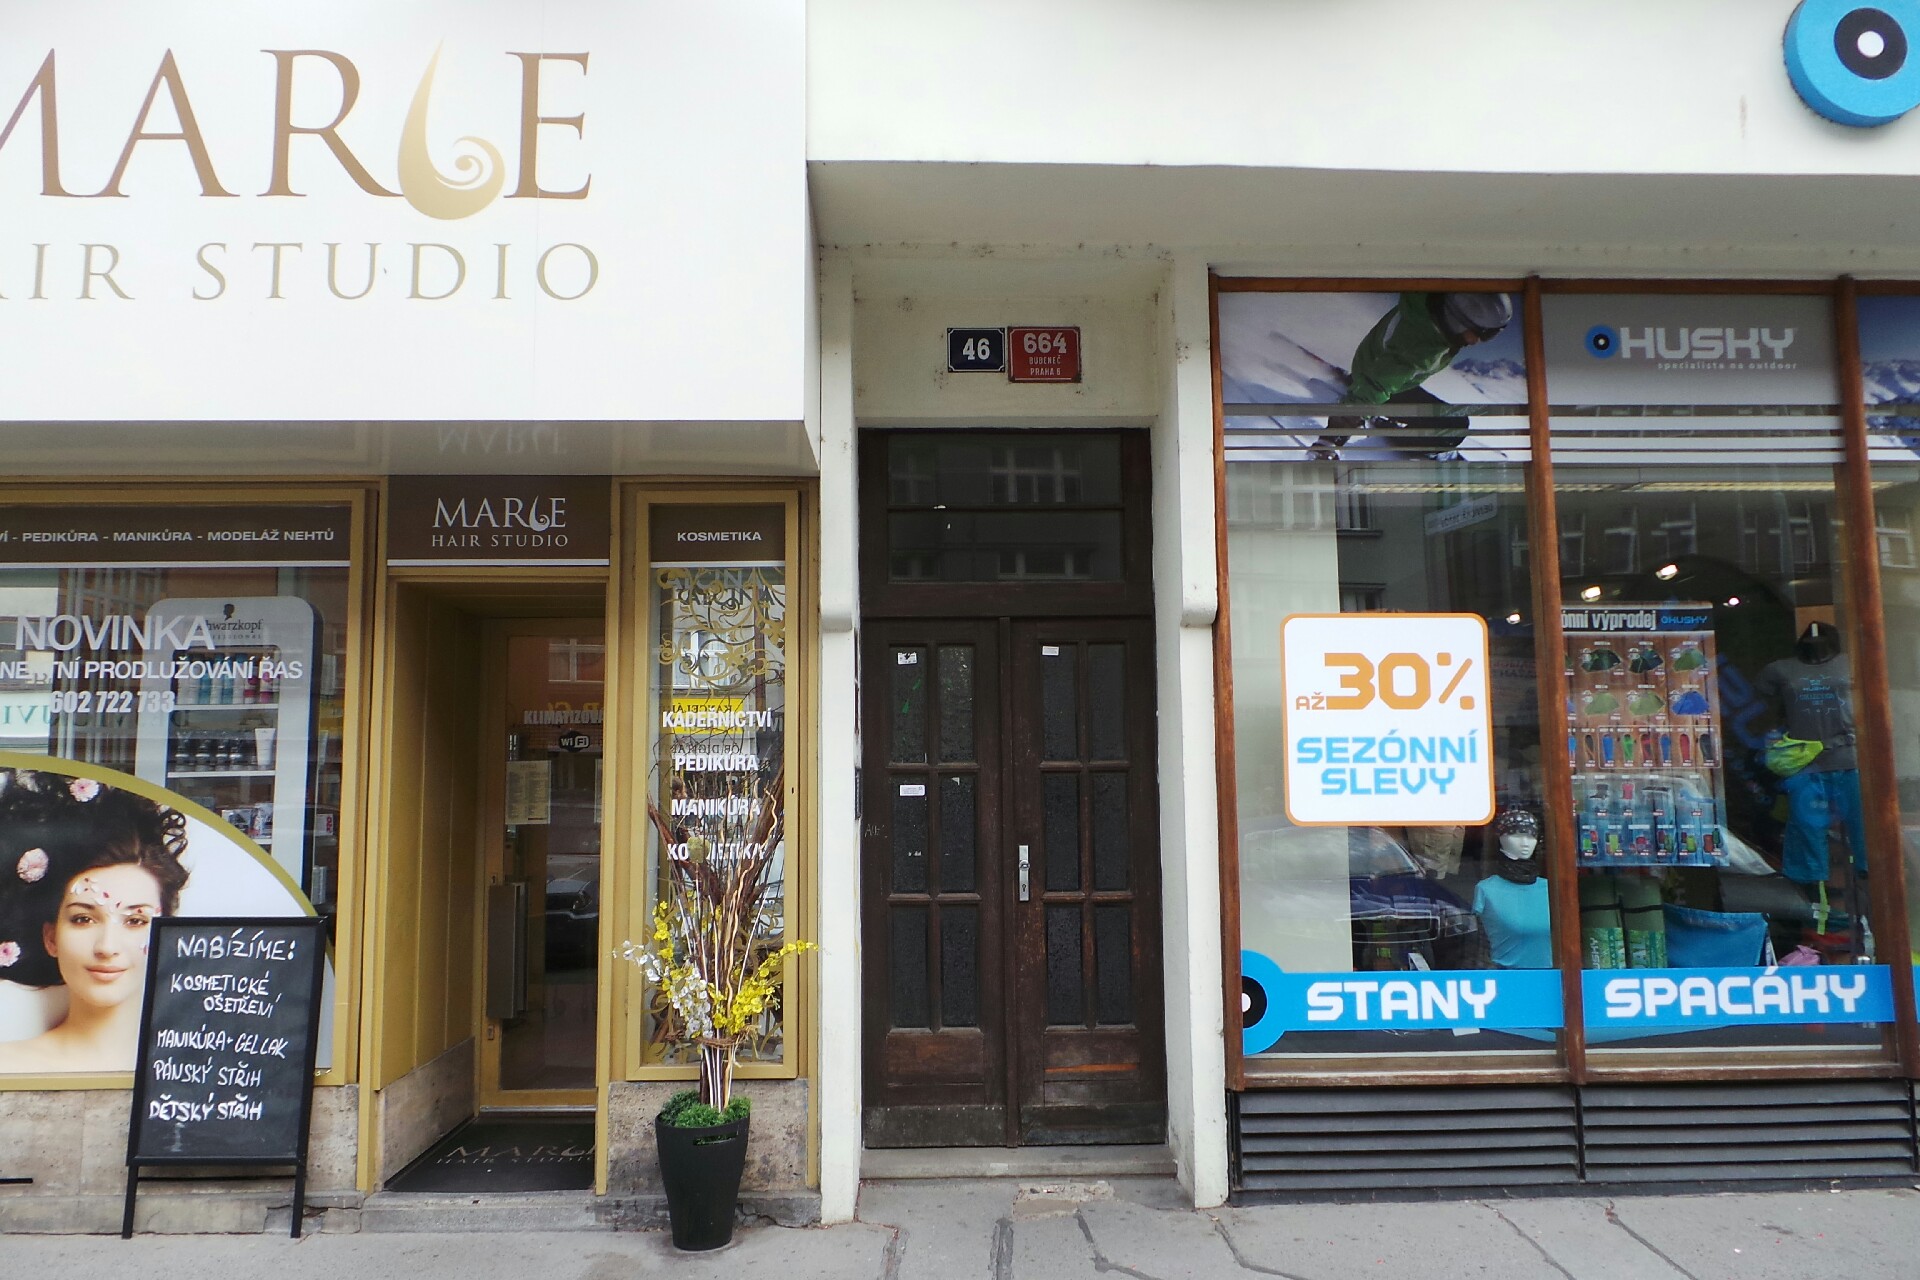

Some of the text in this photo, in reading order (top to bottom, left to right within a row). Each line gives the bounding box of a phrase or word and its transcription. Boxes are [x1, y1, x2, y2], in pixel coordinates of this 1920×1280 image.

[0, 242, 599, 300] IR STUDIO
[962, 337, 991, 361] 46
[1023, 332, 1067, 354] 664
[1620, 327, 1795, 359] HUSKY
[1030, 367, 1061, 376] PRAHA 6
[207, 530, 280, 542] MODELÁŽ
[431, 533, 569, 547] HAIR STUDIO
[677, 530, 762, 542] KOSMETIKA
[15, 614, 216, 651] NOVINKA
[195, 618, 264, 633] hwarzkopf
[1592, 610, 1657, 631] výprodej
[84, 656, 254, 679] PRODLUŽOVÁNÍ
[258, 656, 303, 679] ŘAS
[1295, 691, 1325, 711] AŽ
[1324, 652, 1476, 711] 30%
[51, 690, 176, 713] 602 722 733
[662, 707, 772, 728] KADEŘNICTVÍ
[1297, 729, 1479, 764] SEZÓNNÍ
[674, 751, 759, 771] PEDIKÚRA
[1321, 768, 1456, 796] SLEVY
[671, 794, 761, 816] MANIKÚRA
[170, 970, 271, 996] KOSMETICKÉ
[1604, 966, 1866, 1019] SPACÁKY
[203, 993, 282, 1018] OŠETŘENÍ
[1307, 979, 1497, 1021] STANY
[153, 1056, 262, 1087] PÁNSKÝ STŘIH
[149, 1092, 263, 1122] DĚTSKÝ STŘIH
